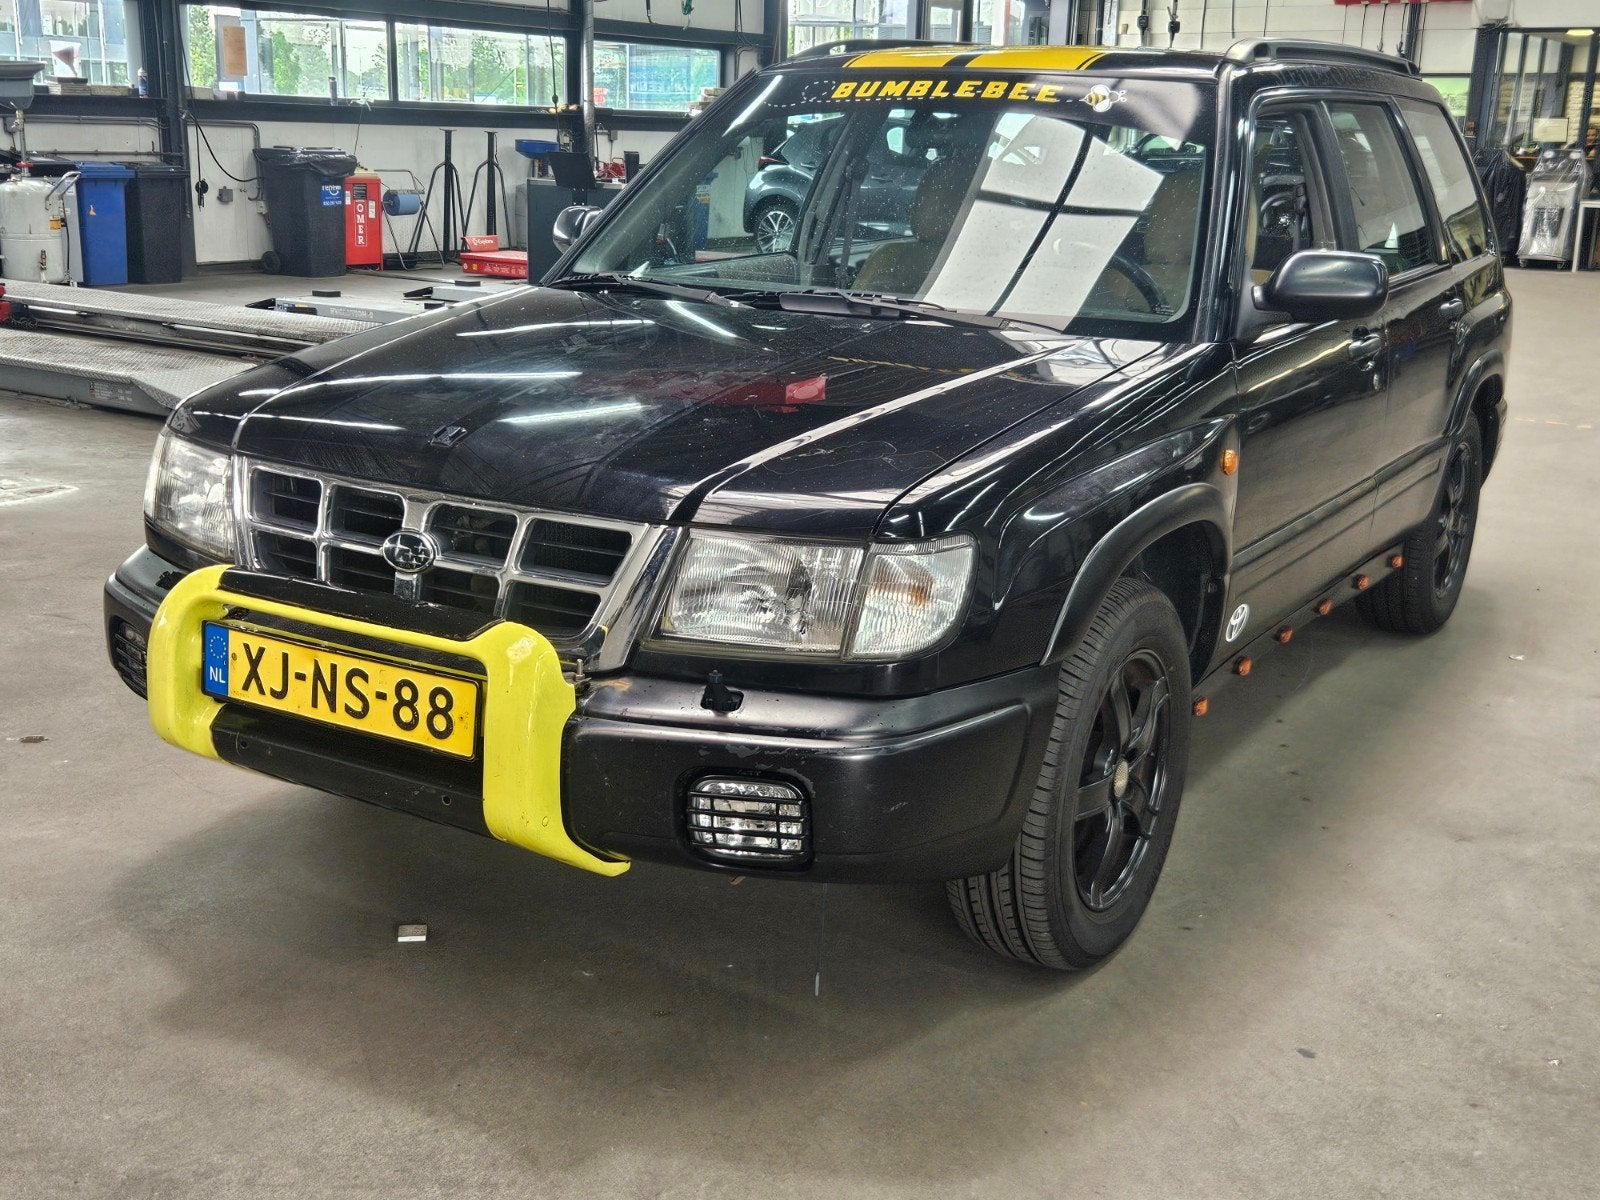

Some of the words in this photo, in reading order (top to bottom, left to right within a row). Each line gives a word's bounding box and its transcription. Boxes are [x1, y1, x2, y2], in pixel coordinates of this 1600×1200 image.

[831, 80, 1064, 103] BUMBLEBEE
[356, 203, 365, 245] OMER
[209, 666, 226, 684] NL
[241, 642, 454, 740] XJ-NS-88
